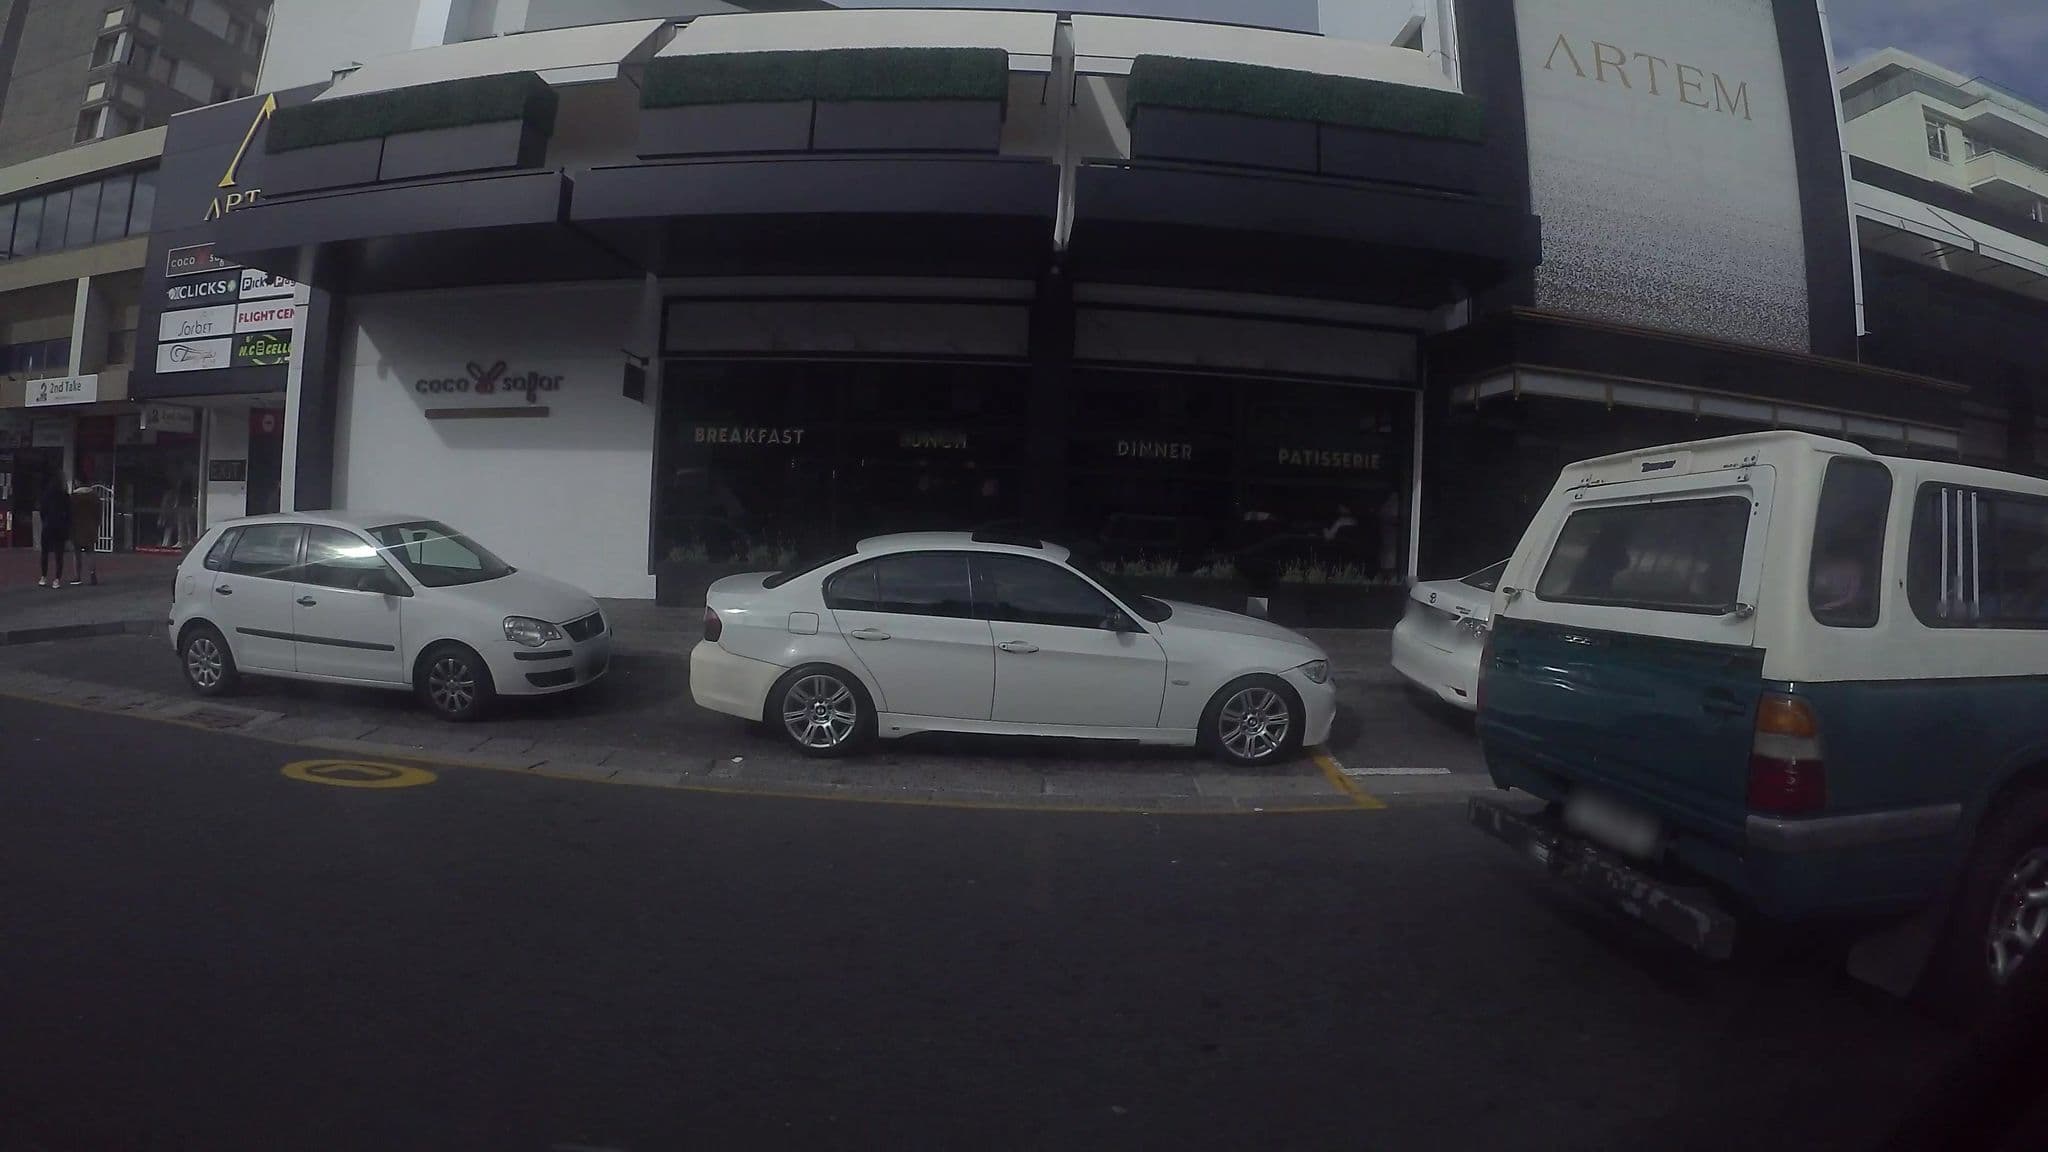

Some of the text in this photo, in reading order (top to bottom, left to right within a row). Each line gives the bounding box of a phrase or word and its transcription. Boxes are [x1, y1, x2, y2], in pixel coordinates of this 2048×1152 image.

[1544, 33, 1752, 121] ARTEM
[179, 280, 227, 299] CLICKS
[238, 310, 275, 323] FLIGHT
[265, 343, 291, 355] CELL
[50, 381, 64, 394] 2nd
[65, 379, 82, 392] Take
[415, 378, 469, 394] coco
[695, 427, 805, 445] BREAKFAST
[1117, 440, 1193, 461] DINNER
[1278, 447, 1381, 470] PATISSERIE
